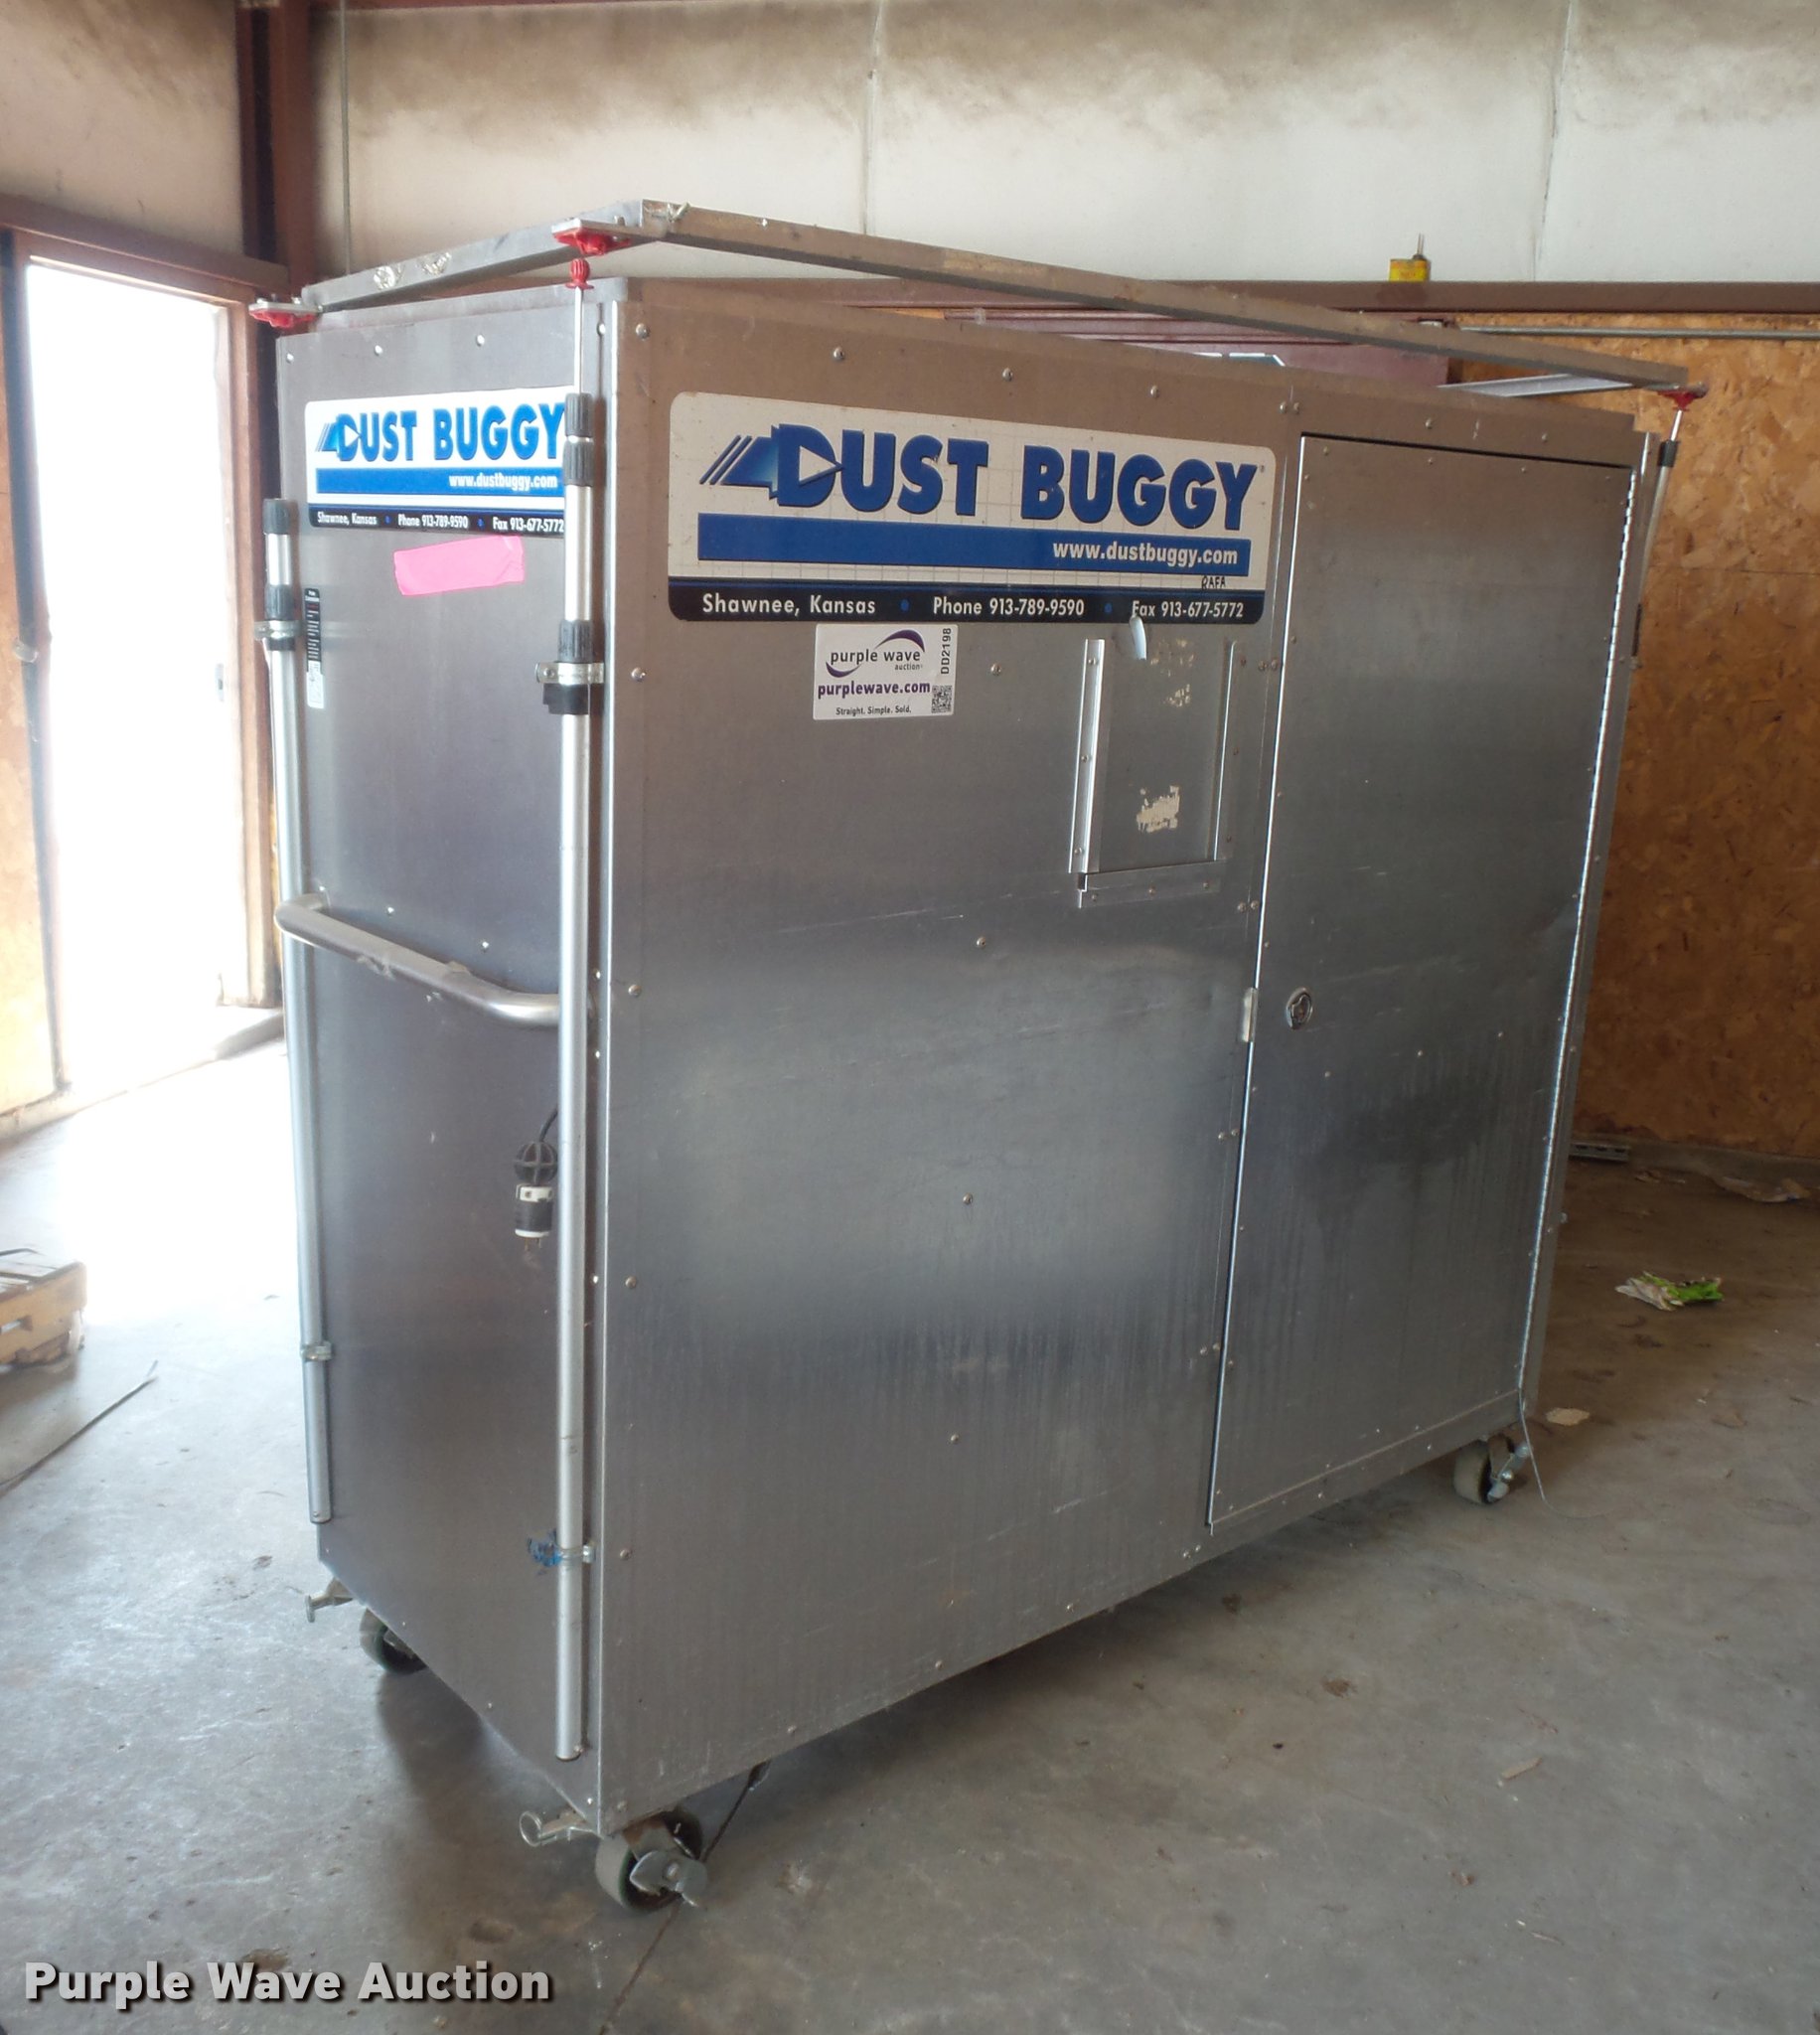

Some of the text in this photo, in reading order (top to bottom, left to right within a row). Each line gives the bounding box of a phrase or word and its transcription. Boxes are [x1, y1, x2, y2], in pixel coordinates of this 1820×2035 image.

[335, 402, 565, 462] DUST BUGGY
[449, 472, 558, 492] www.dustbuggy.com
[770, 423, 1258, 531] DUST BUGGY
[317, 511, 378, 526] Shawnee, Kansas
[397, 514, 469, 529] Phone 913-789-9590
[493, 517, 564, 533] Fax 913-677-5772
[1053, 542, 1238, 568] www.dustbuggy.com
[702, 593, 876, 616] Shawnee, Kansas
[933, 597, 1085, 616] Phone 913-789-9590
[1133, 600, 1244, 618] Fax 913-677-5772
[831, 649, 921, 666] purple wave
[940, 628, 952, 675] DD2198
[818, 681, 931, 700] purplewave.com
[835, 704, 912, 716] Straight. Simple. Sold.
